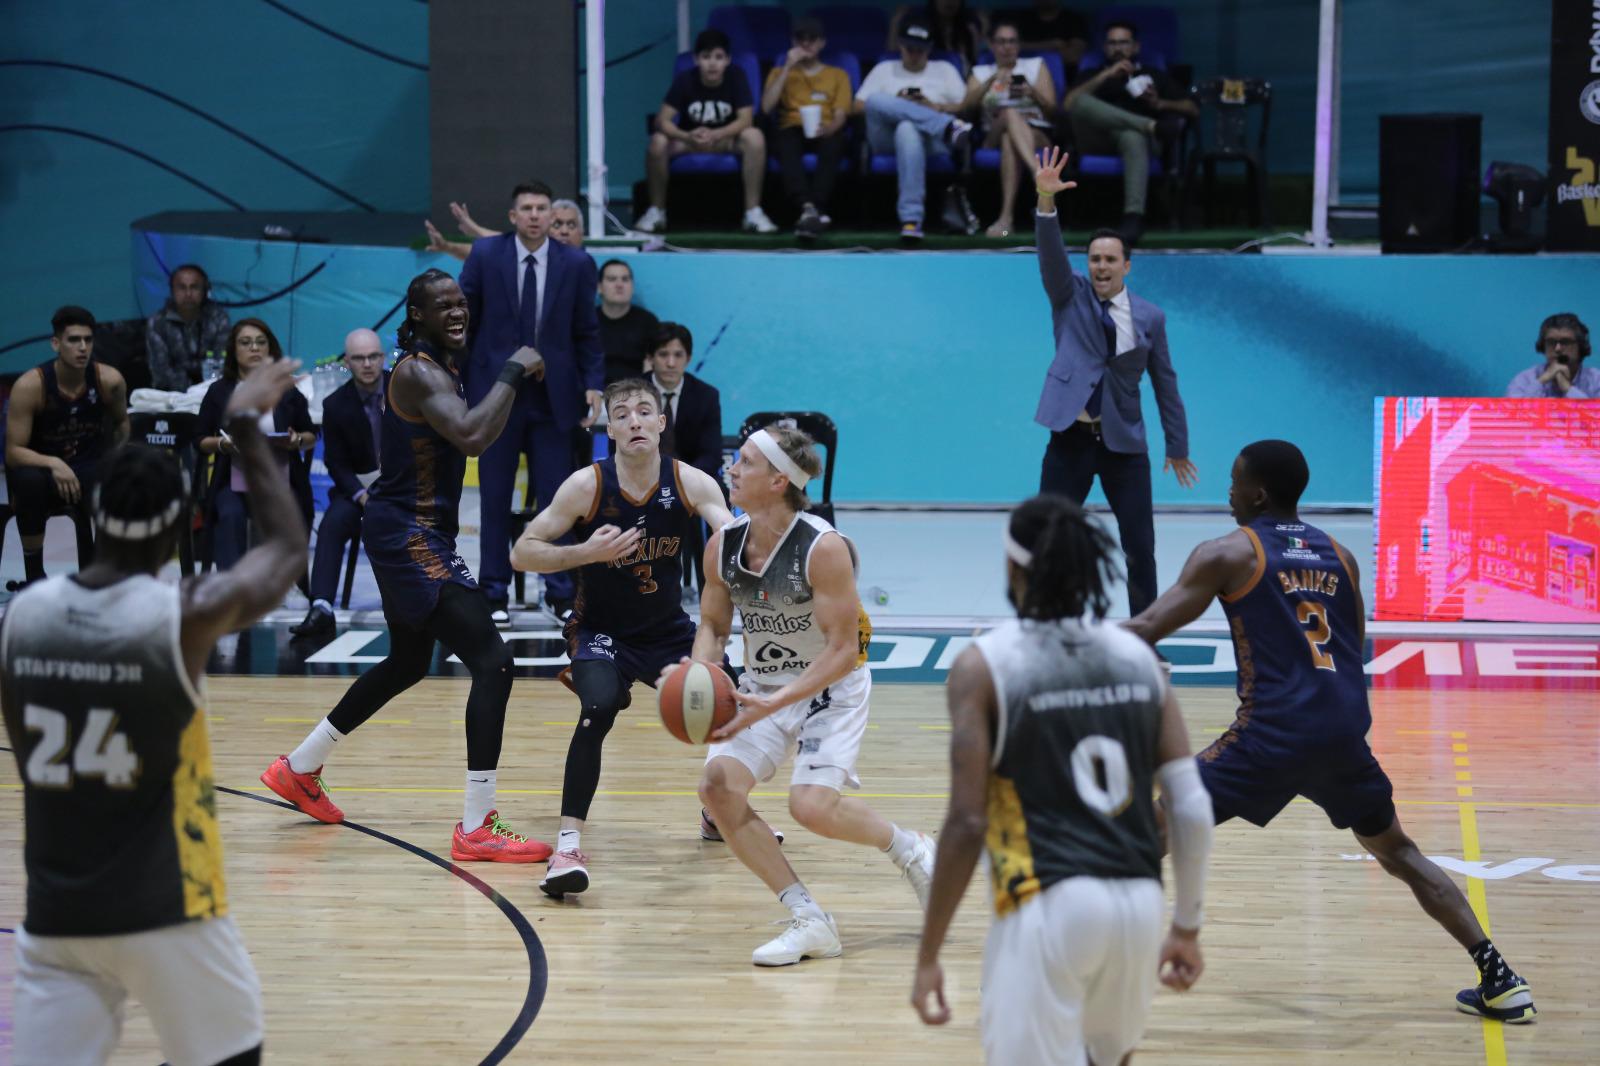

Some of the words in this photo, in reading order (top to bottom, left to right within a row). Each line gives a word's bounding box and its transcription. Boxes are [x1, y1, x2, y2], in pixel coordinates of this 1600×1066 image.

[688, 101, 732, 123] GAP
[146, 433, 176, 445] TECATE
[607, 536, 681, 569] XICO
[632, 564, 659, 595] 3
[1277, 569, 1339, 597] BANKS
[741, 611, 813, 635] enados
[1296, 600, 1337, 672] 2
[23, 703, 143, 790] 24
[1070, 734, 1134, 816] 0
